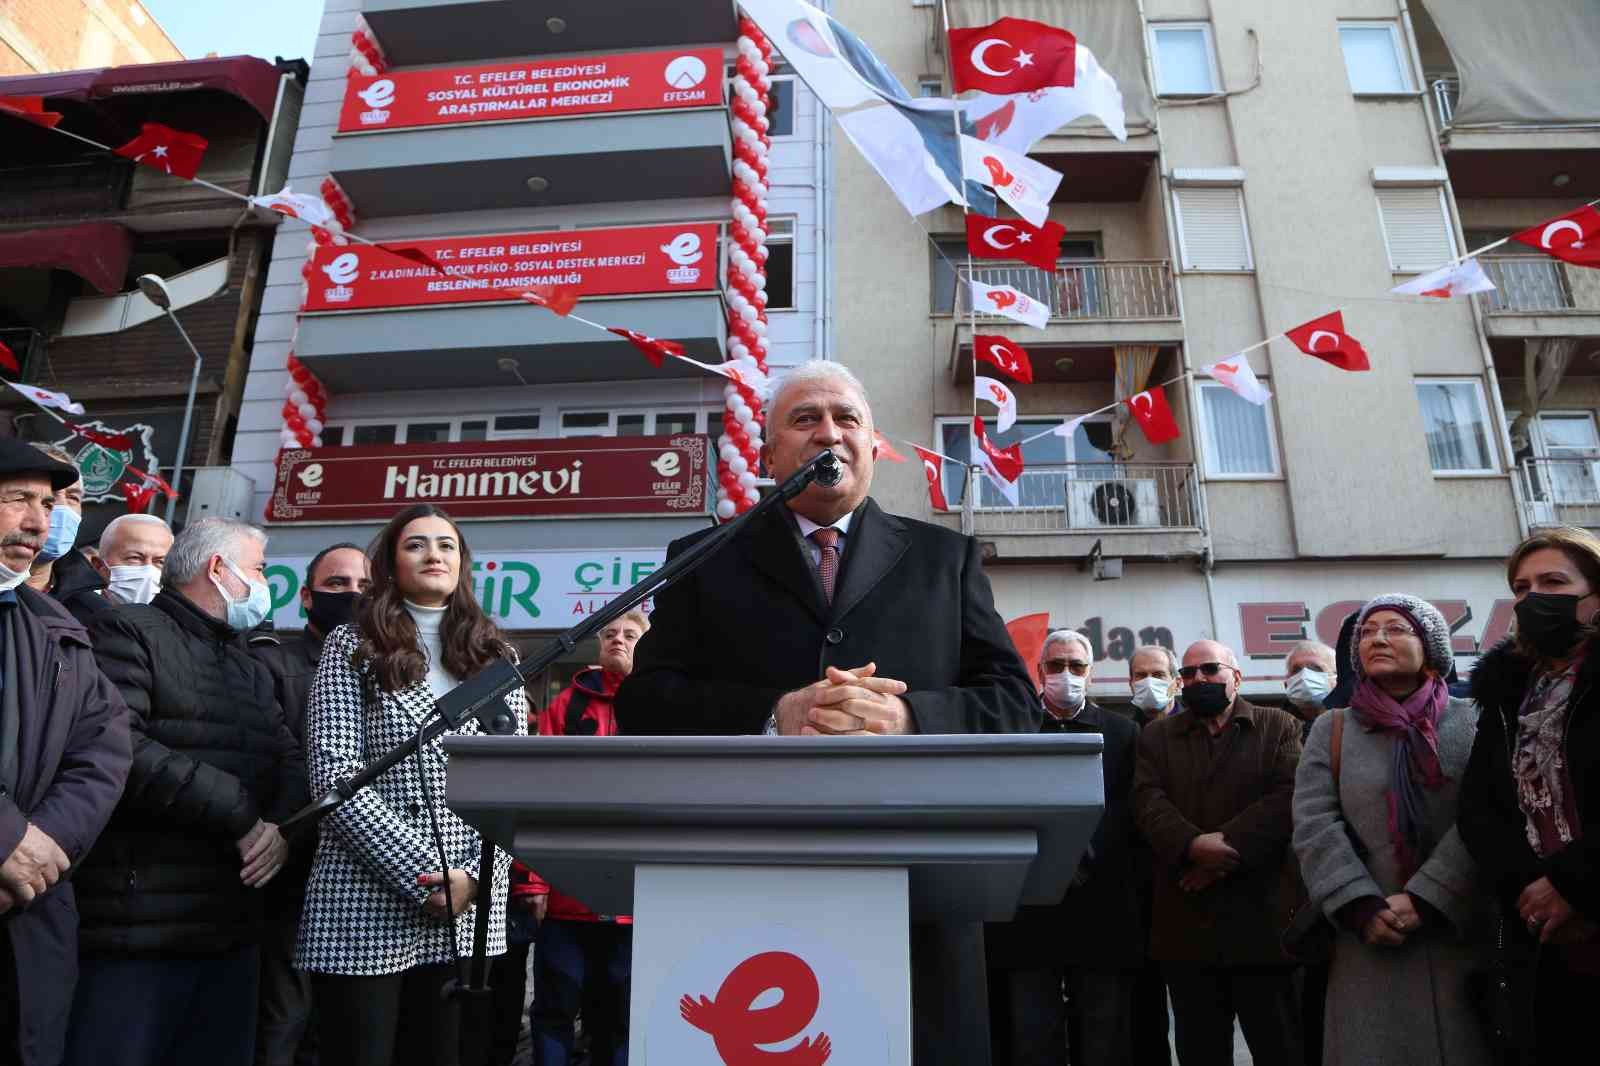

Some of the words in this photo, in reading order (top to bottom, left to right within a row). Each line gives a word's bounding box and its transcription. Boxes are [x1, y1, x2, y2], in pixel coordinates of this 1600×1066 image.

[454, 75, 474, 86] T.C.
[479, 71, 526, 83] EFELER
[531, 64, 607, 80] BELEDİYESİ
[427, 91, 478, 103] SOSYAL
[482, 82, 549, 98] KÜLTÜREL
[553, 76, 630, 92] EKONOMİK
[663, 90, 705, 102] EFESAM
[438, 97, 547, 116] ARAŞTIRMALAR
[551, 91, 612, 107] MERKEZİ
[460, 246, 505, 258] EFELER
[510, 240, 582, 256] BELEDİYESİ
[476, 261, 508, 273] PSİKO
[513, 259, 553, 272] SOSYAL
[556, 257, 595, 270] DESTEK
[597, 252, 645, 267] MERKEZİ
[427, 279, 488, 292] BESLENME
[448, 458, 483, 469] EFELER
[484, 455, 537, 467] BELEDİYESİ
